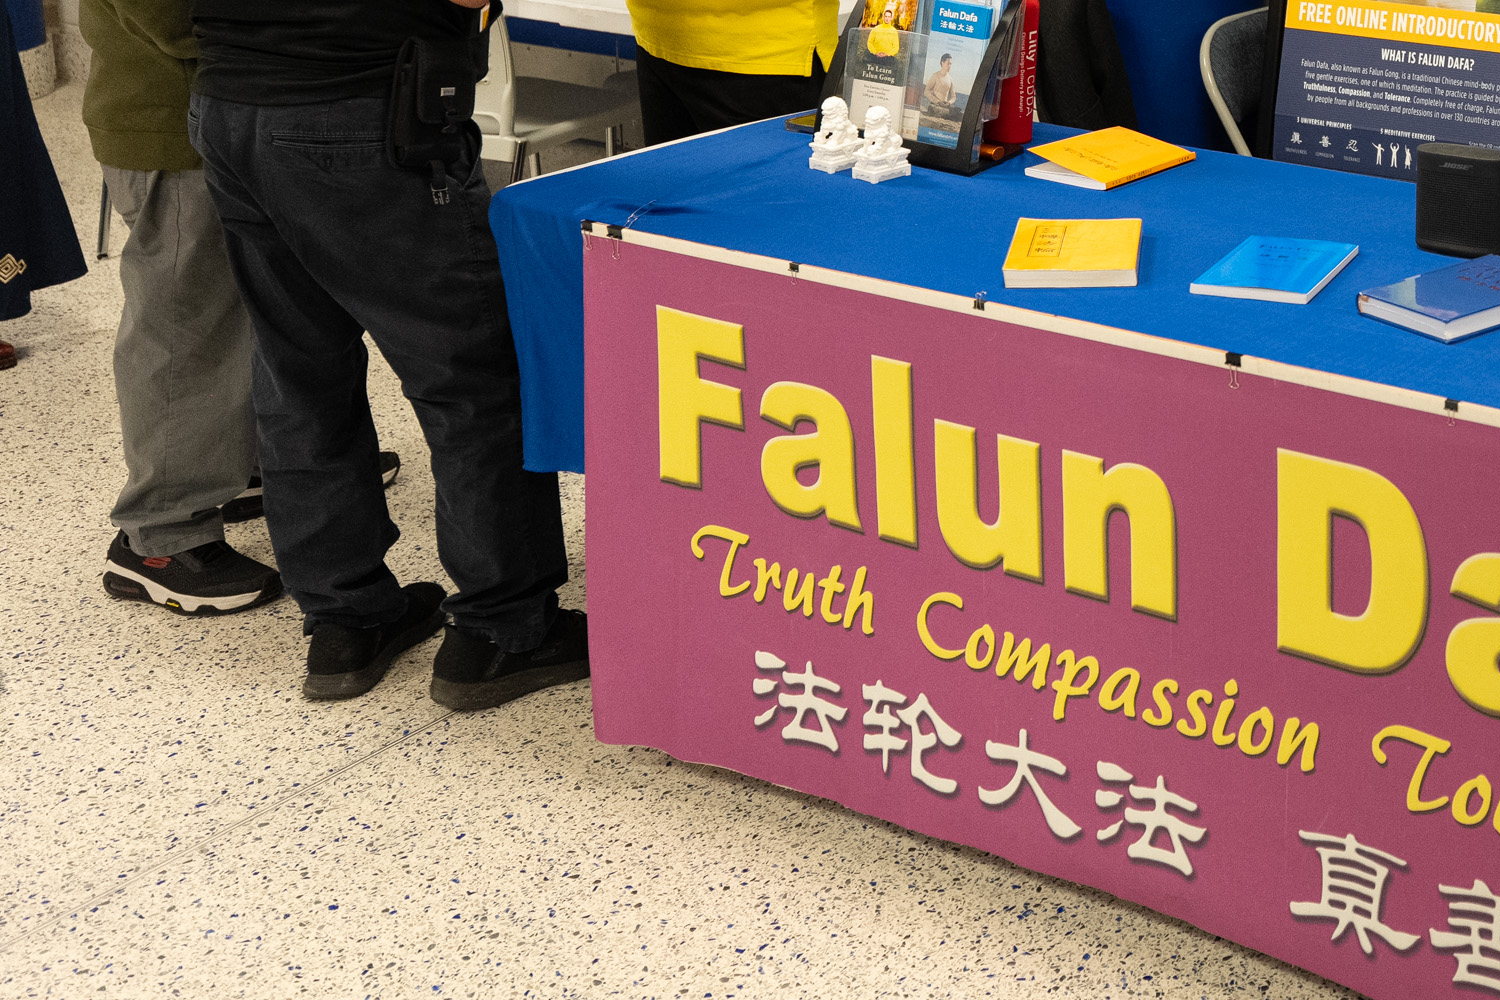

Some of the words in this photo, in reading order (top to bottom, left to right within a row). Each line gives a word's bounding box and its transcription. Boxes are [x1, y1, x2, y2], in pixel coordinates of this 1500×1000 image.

[940, 8, 959, 19] Falun
[960, 11, 978, 22] Dafa
[1298, 1, 1331, 24] FREE
[1336, 6, 1388, 31] ONLINE
[1026, 30, 1037, 61] Lilly
[1381, 48, 1406, 63] WHAT
[1408, 51, 1415, 64] IS
[1418, 53, 1445, 67] FALUN
[1447, 57, 1475, 71] DAFA?
[862, 71, 877, 79] Falun
[879, 73, 895, 84] Gong
[876, 66, 892, 74] Learn
[1301, 58, 1315, 68] Falun
[1316, 60, 1329, 70] Dafa,
[1331, 63, 1342, 71] also
[1343, 64, 1360, 74] known
[1369, 67, 1383, 76] Falun
[1385, 69, 1400, 79] Gong,
[1412, 73, 1440, 84] traditional
[1442, 76, 1462, 87] Chinese
[1464, 80, 1495, 92] mind-body
[1303, 82, 1337, 94] Truthfulness,
[1338, 86, 1372, 98] Compassion,
[1384, 92, 1412, 103] Tolerance.
[1413, 96, 1444, 108] Completely
[1445, 100, 1456, 109] free
[1464, 102, 1485, 113] charge,
[1486, 105, 1500, 115] Falun
[1305, 70, 1315, 79] five
[1316, 73, 1333, 82] gentle
[1334, 76, 1359, 85] exercises,
[1379, 80, 1394, 90] which
[1402, 83, 1432, 94] meditation.
[1435, 87, 1444, 96] The
[1445, 89, 1467, 99] practice
[1474, 94, 1493, 102] guided
[1315, 95, 1333, 104] people
[1334, 97, 1347, 106] from
[1356, 100, 1389, 112] backgrounds
[1402, 107, 1433, 118] professions
[1441, 112, 1453, 120] over
[1454, 113, 1463, 121] 130
[1464, 115, 1490, 126] countries
[1440, 162, 1473, 170] BOSE
[655, 304, 1178, 623] Falun
[690, 524, 875, 636] Truth
[916, 592, 1320, 773] Compassion
[753, 650, 1207, 877] 法轮大法
